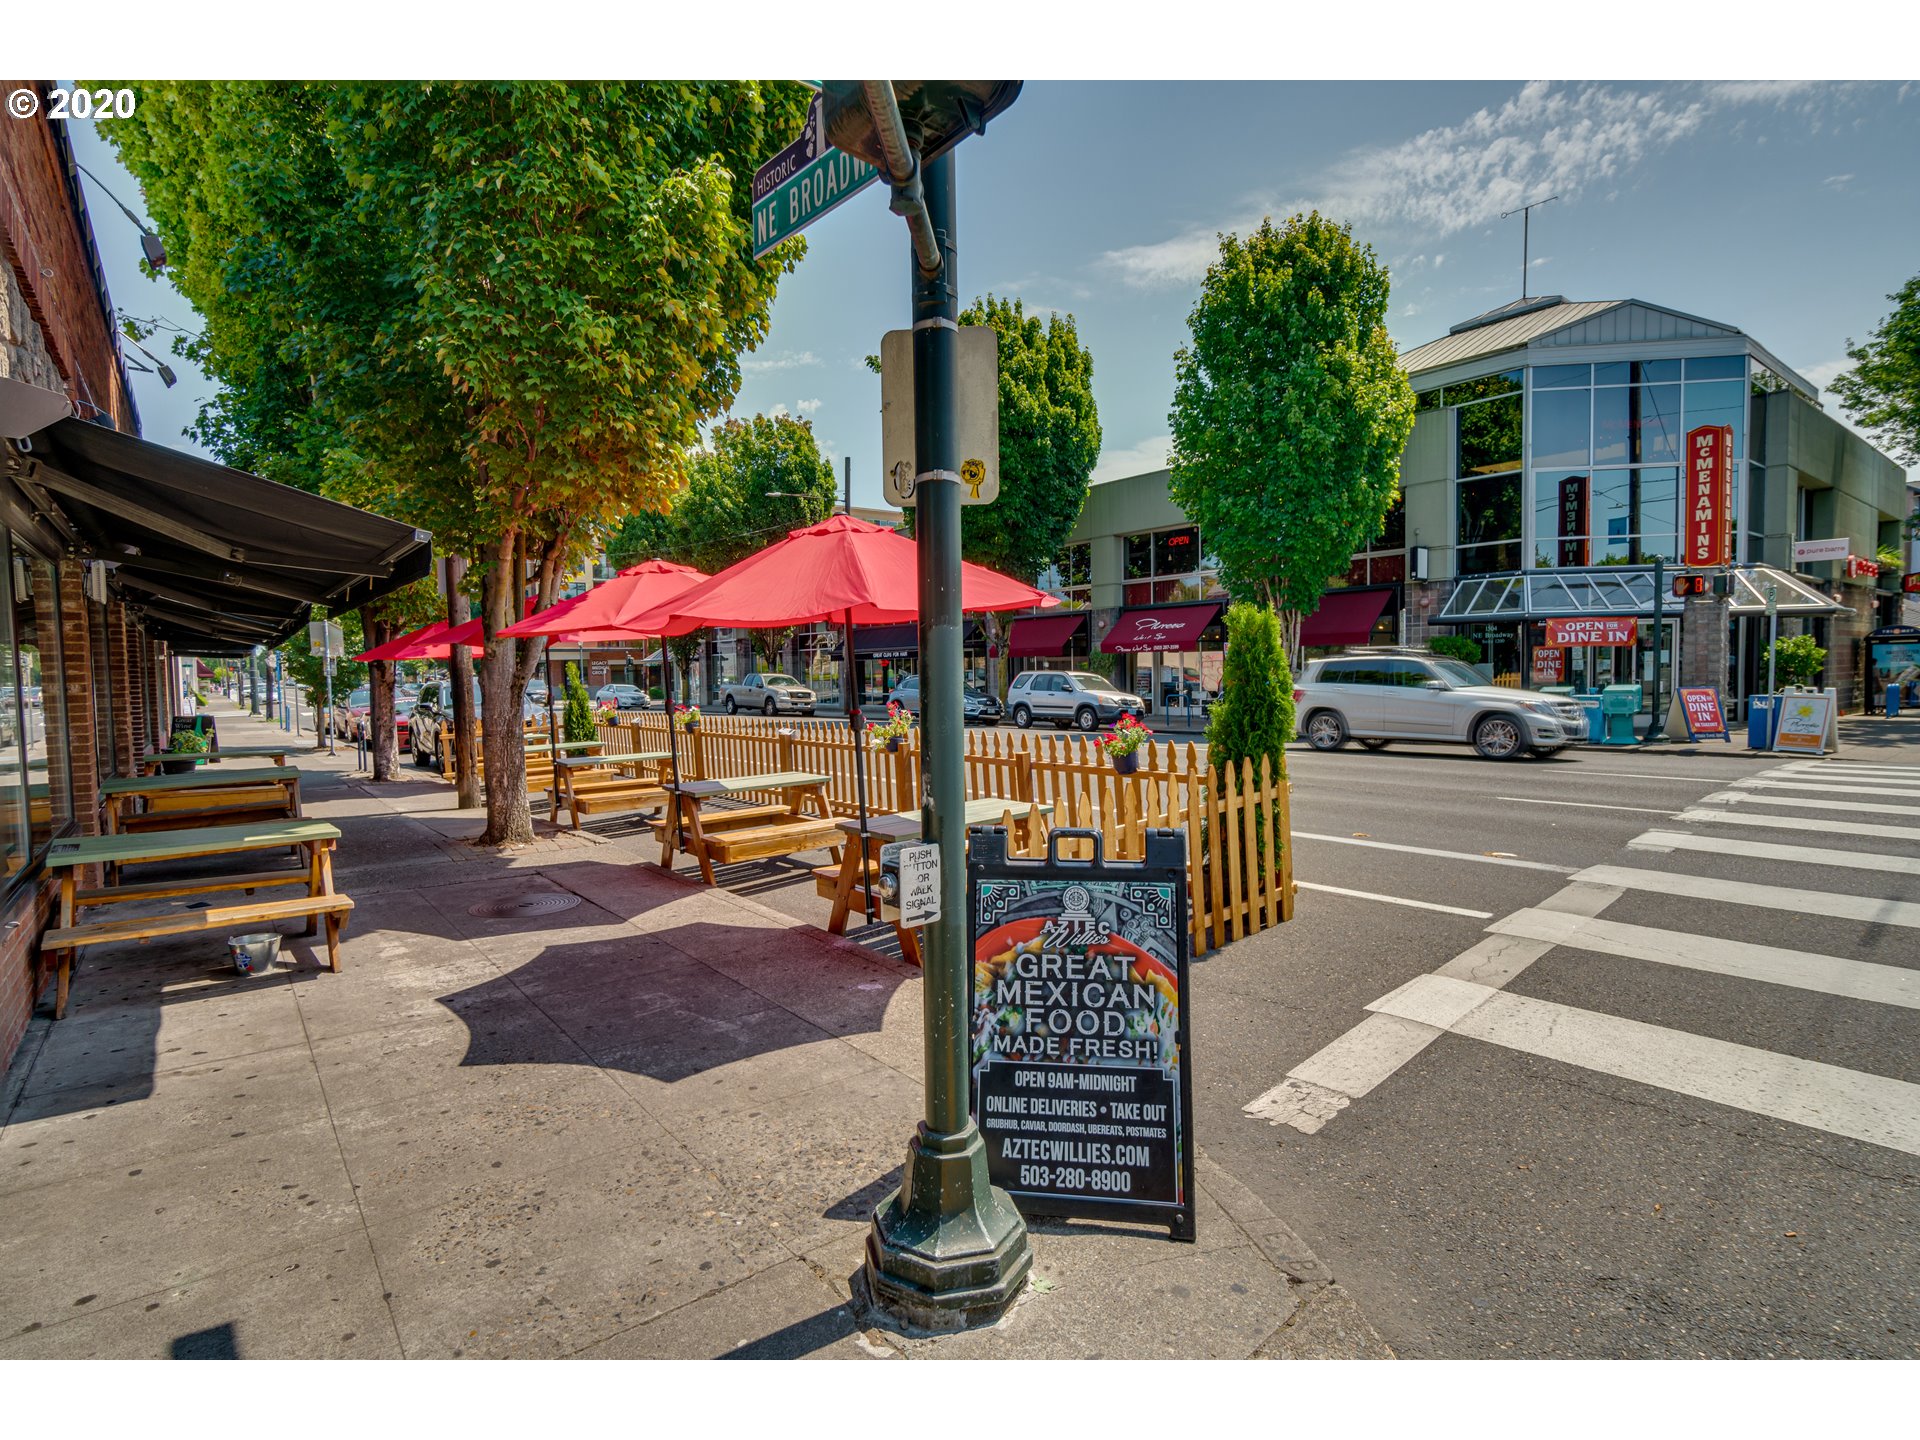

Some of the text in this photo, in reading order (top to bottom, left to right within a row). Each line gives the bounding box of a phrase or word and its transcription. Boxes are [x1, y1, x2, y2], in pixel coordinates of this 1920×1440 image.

[757, 154, 796, 197] HISTORIC
[757, 150, 873, 246] NE BROADW
[1168, 536, 1190, 546] OPEN
[1565, 621, 1604, 631] OPEN
[1557, 631, 1629, 643] DINE IN
[1538, 650, 1560, 658] OPEN
[1537, 660, 1562, 669] DINE
[1543, 668, 1555, 676] IN
[1687, 694, 1706, 702] OPEN
[1688, 702, 1716, 711] DINE
[1697, 712, 1711, 721] IN
[909, 849, 932, 862] PUSH
[905, 896, 937, 910] SIGNAL
[1043, 918, 1110, 935] AZTEC
[1042, 928, 1110, 949] Willies
[1015, 953, 1136, 981] GREAT
[996, 979, 1155, 1009] MEXICAN
[1025, 1008, 1126, 1036] FOOD
[993, 1035, 1159, 1059] MADE FRESH!
[1014, 1070, 1137, 1093] OPEN 9AM-MIDNIGHT
[986, 1095, 1167, 1121] ONLINE DELIVERIES TAKE OUT
[986, 1118, 1167, 1138] GRUBHUB, CAVIAR, DOORDASH, UBEREATS, POSTMATES
[1002, 1137, 1150, 1167] AZTECWILLIES.COM
[1020, 1164, 1131, 1192] 503-280-8900
